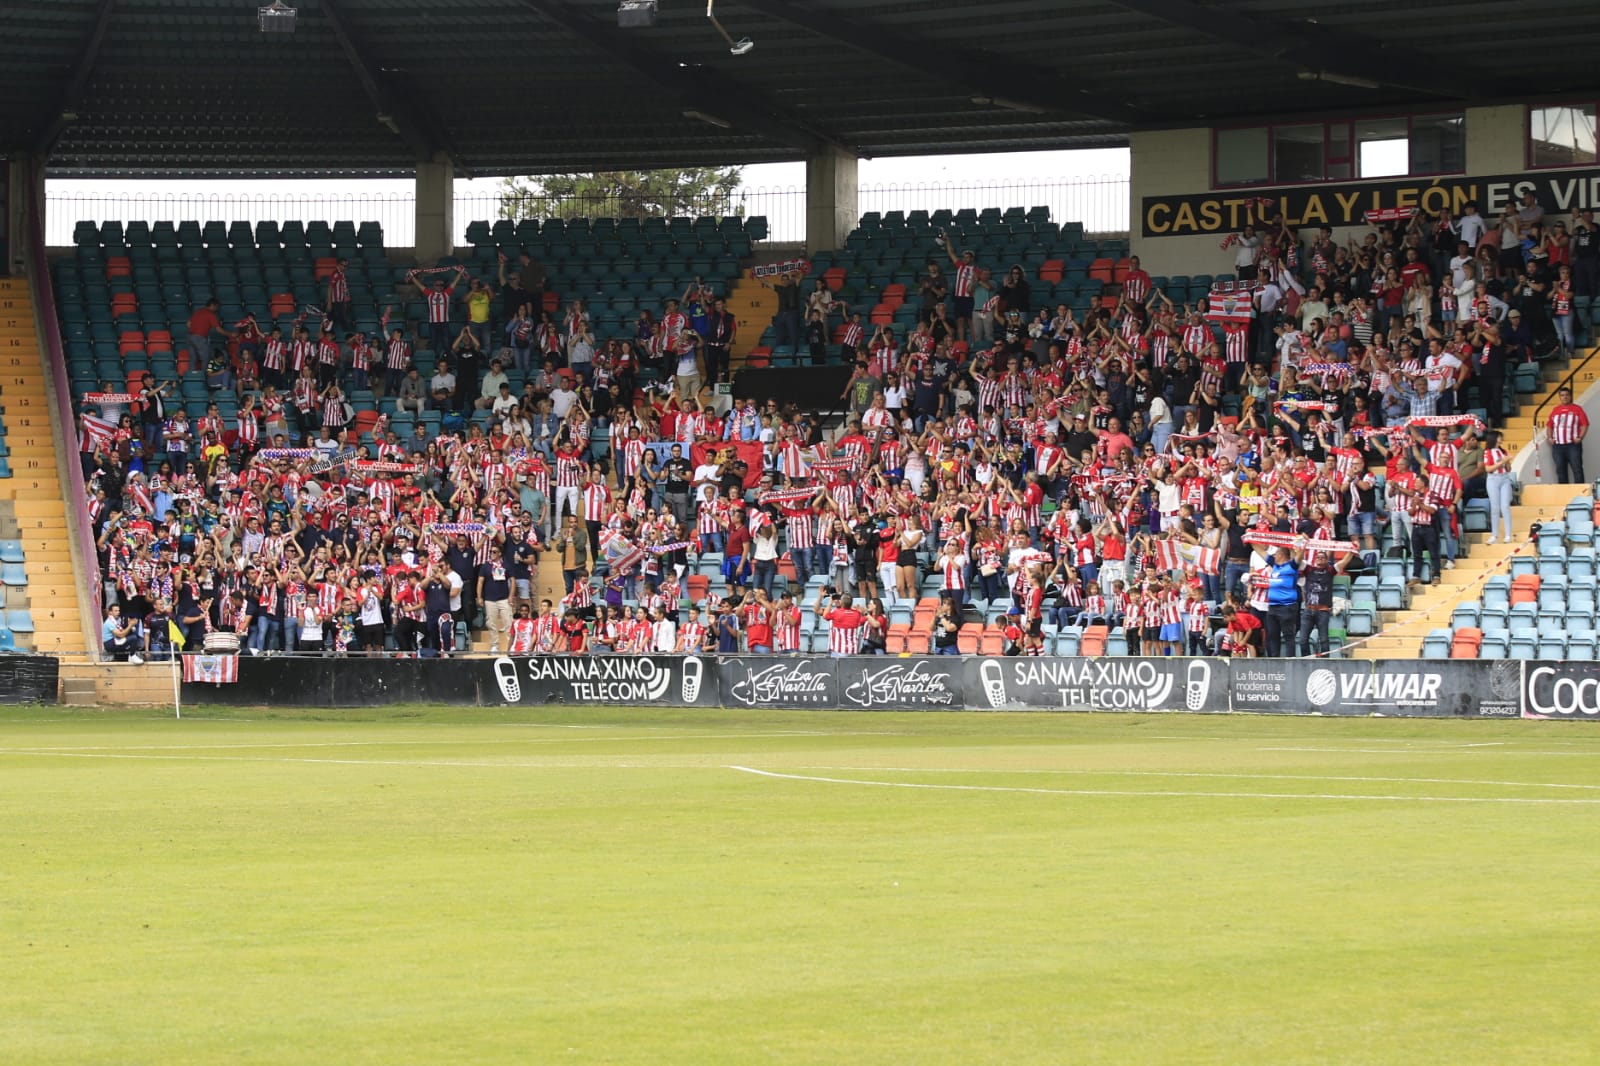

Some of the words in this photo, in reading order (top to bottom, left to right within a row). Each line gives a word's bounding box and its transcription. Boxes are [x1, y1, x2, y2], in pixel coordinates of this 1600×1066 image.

[1334, 191, 1361, 222] Y
[1487, 181, 1536, 214] ES
[1236, 672, 1246, 680] La
[1248, 670, 1266, 680] flota
[571, 682, 648, 700] TELECOM
[1236, 682, 1273, 690] moderna
[1340, 674, 1442, 699] VIAMAR
[1528, 666, 1600, 714] Coc
[1058, 688, 1147, 708] TELECOM
[1236, 692, 1246, 701] tu
[1247, 692, 1280, 702] servicio
